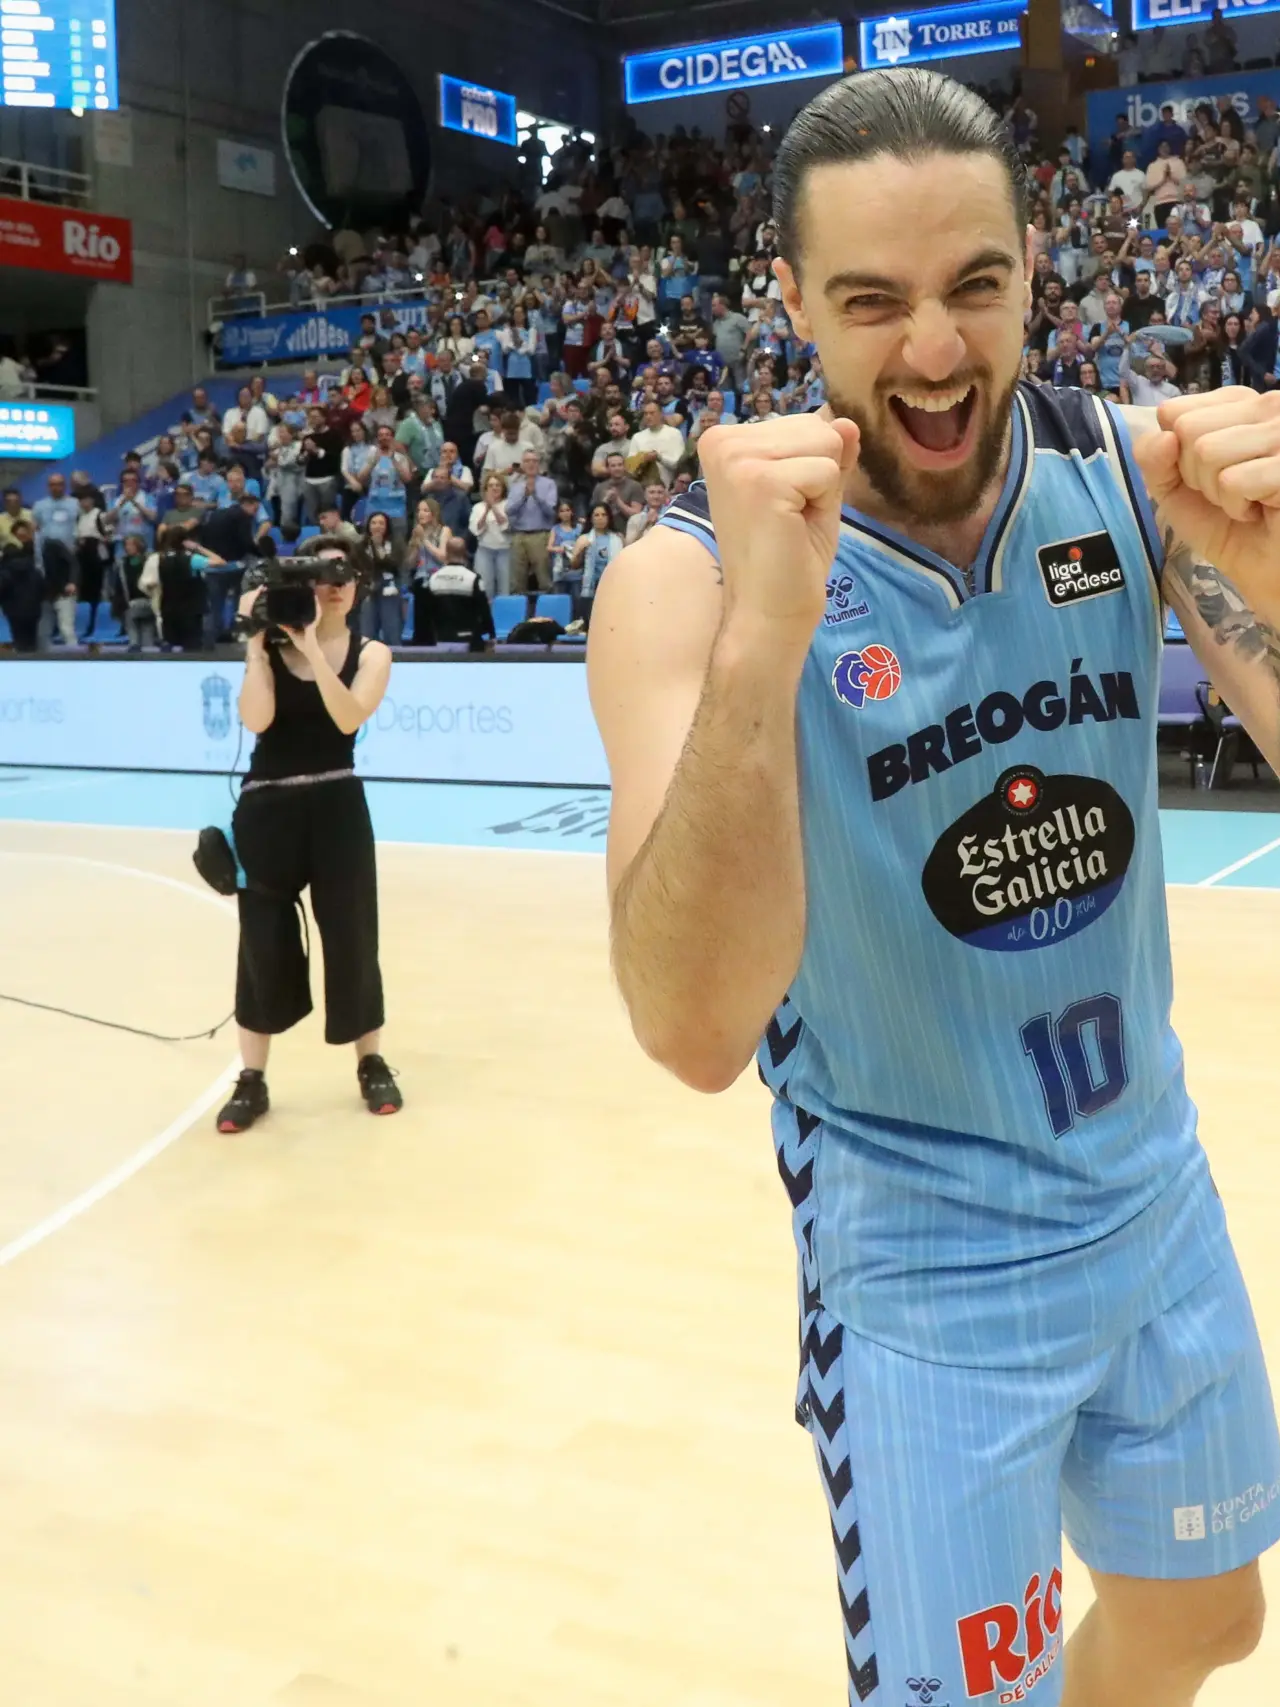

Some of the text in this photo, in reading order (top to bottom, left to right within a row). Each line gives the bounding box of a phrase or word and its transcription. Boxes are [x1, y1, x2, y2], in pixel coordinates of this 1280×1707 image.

[918, 19, 1018, 46] TORRE DE
[462, 100, 498, 136] PRO
[1048, 561, 1082, 581] liga
[1054, 568, 1121, 596] endesa
[824, 601, 870, 625] hummel
[376, 695, 514, 741] Deportes
[866, 657, 1141, 803] BREOGÁN
[957, 804, 1108, 879] Estrella
[972, 846, 1109, 916] Galicia
[1029, 896, 1073, 941] 0,0
[1019, 992, 1130, 1141] 10
[1212, 1482, 1264, 1517] XUNTA
[1211, 1516, 1234, 1534] DE
[1000, 1684, 1026, 1705] DE
